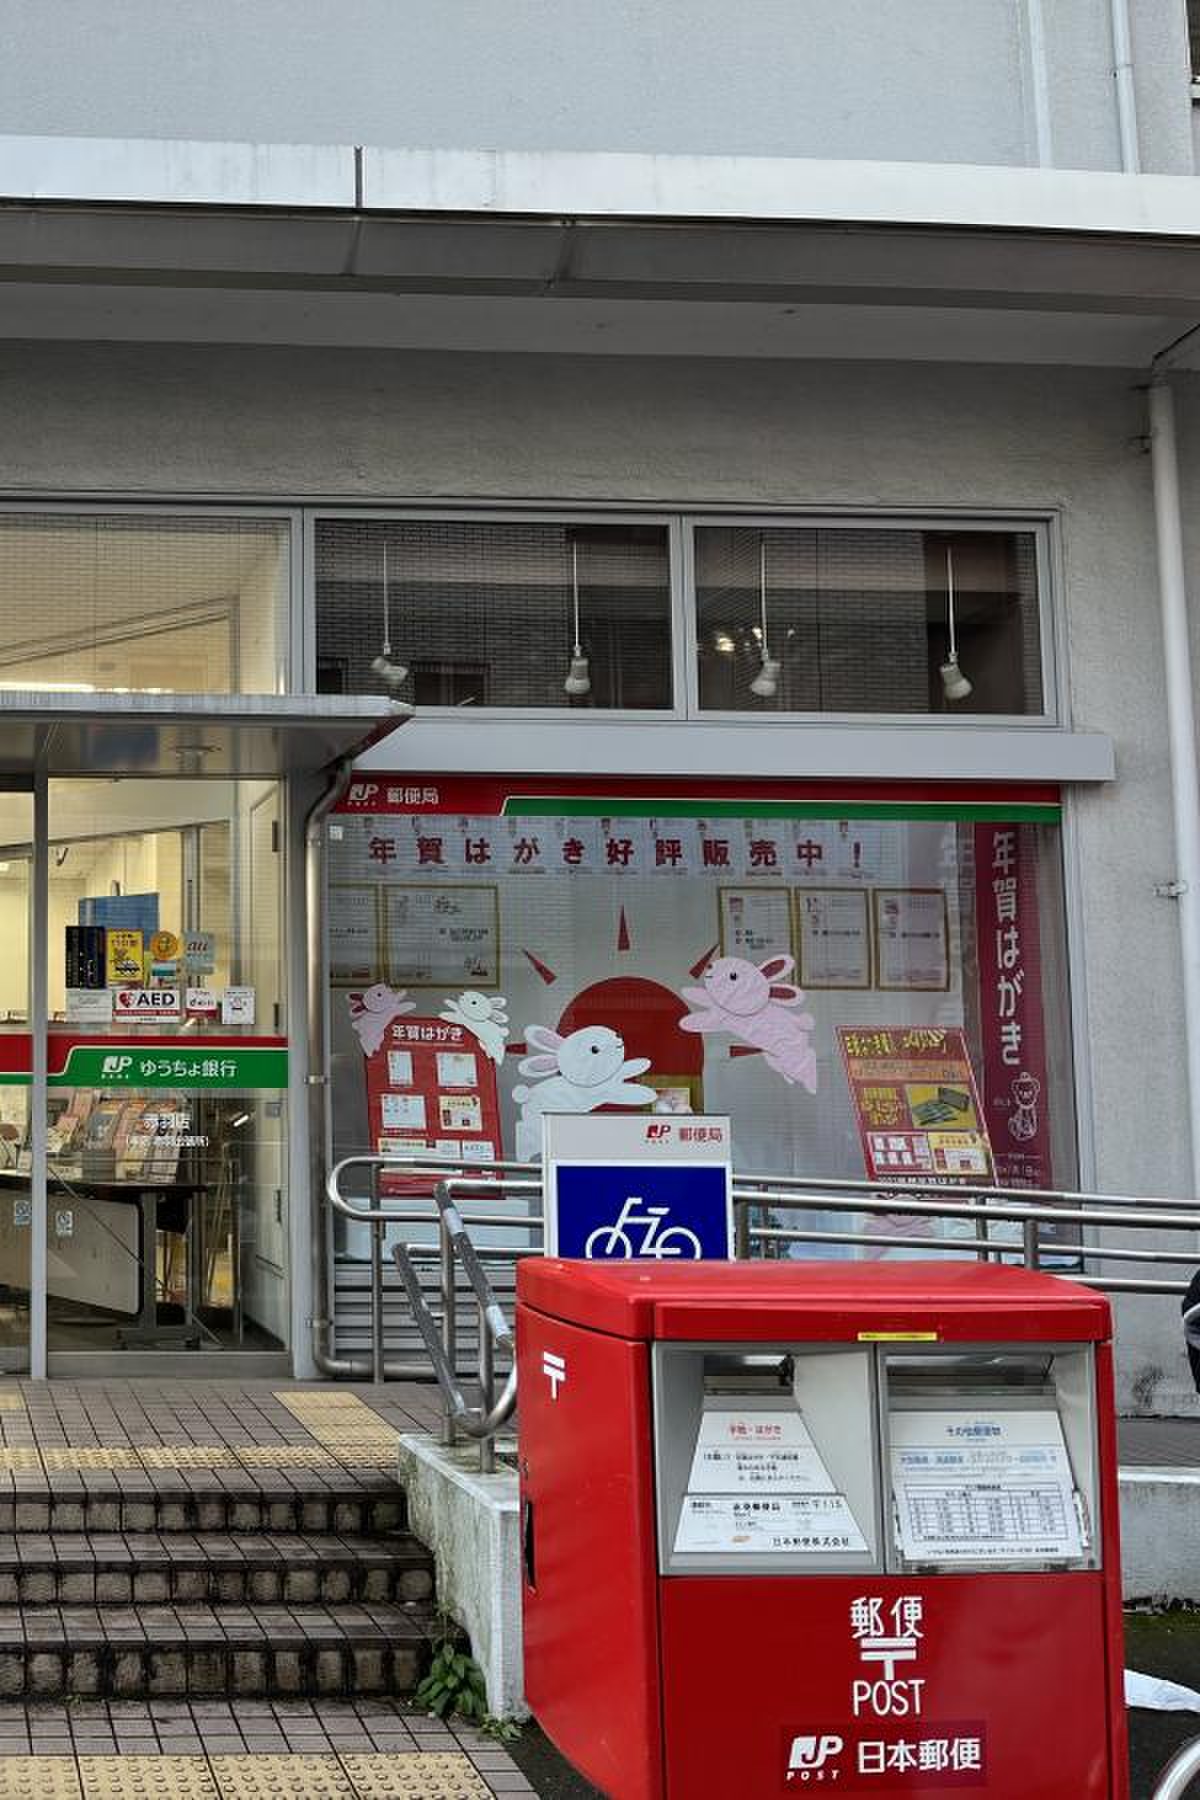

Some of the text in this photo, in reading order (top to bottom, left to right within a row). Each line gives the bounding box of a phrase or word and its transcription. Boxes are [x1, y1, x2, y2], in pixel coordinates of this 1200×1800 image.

[387, 786, 439, 805] 郵便局
[991, 831, 1026, 1066] 年賀はがき
[137, 992, 175, 1007] AED
[392, 1024, 464, 1041] 年賀はがき
[140, 1059, 238, 1078] ゆうちょ銀行
[679, 1126, 722, 1142] 郵便局
[850, 1596, 924, 1639] 郵便
[853, 1679, 926, 1716] POST
[857, 1737, 982, 1774] 日本郵便
